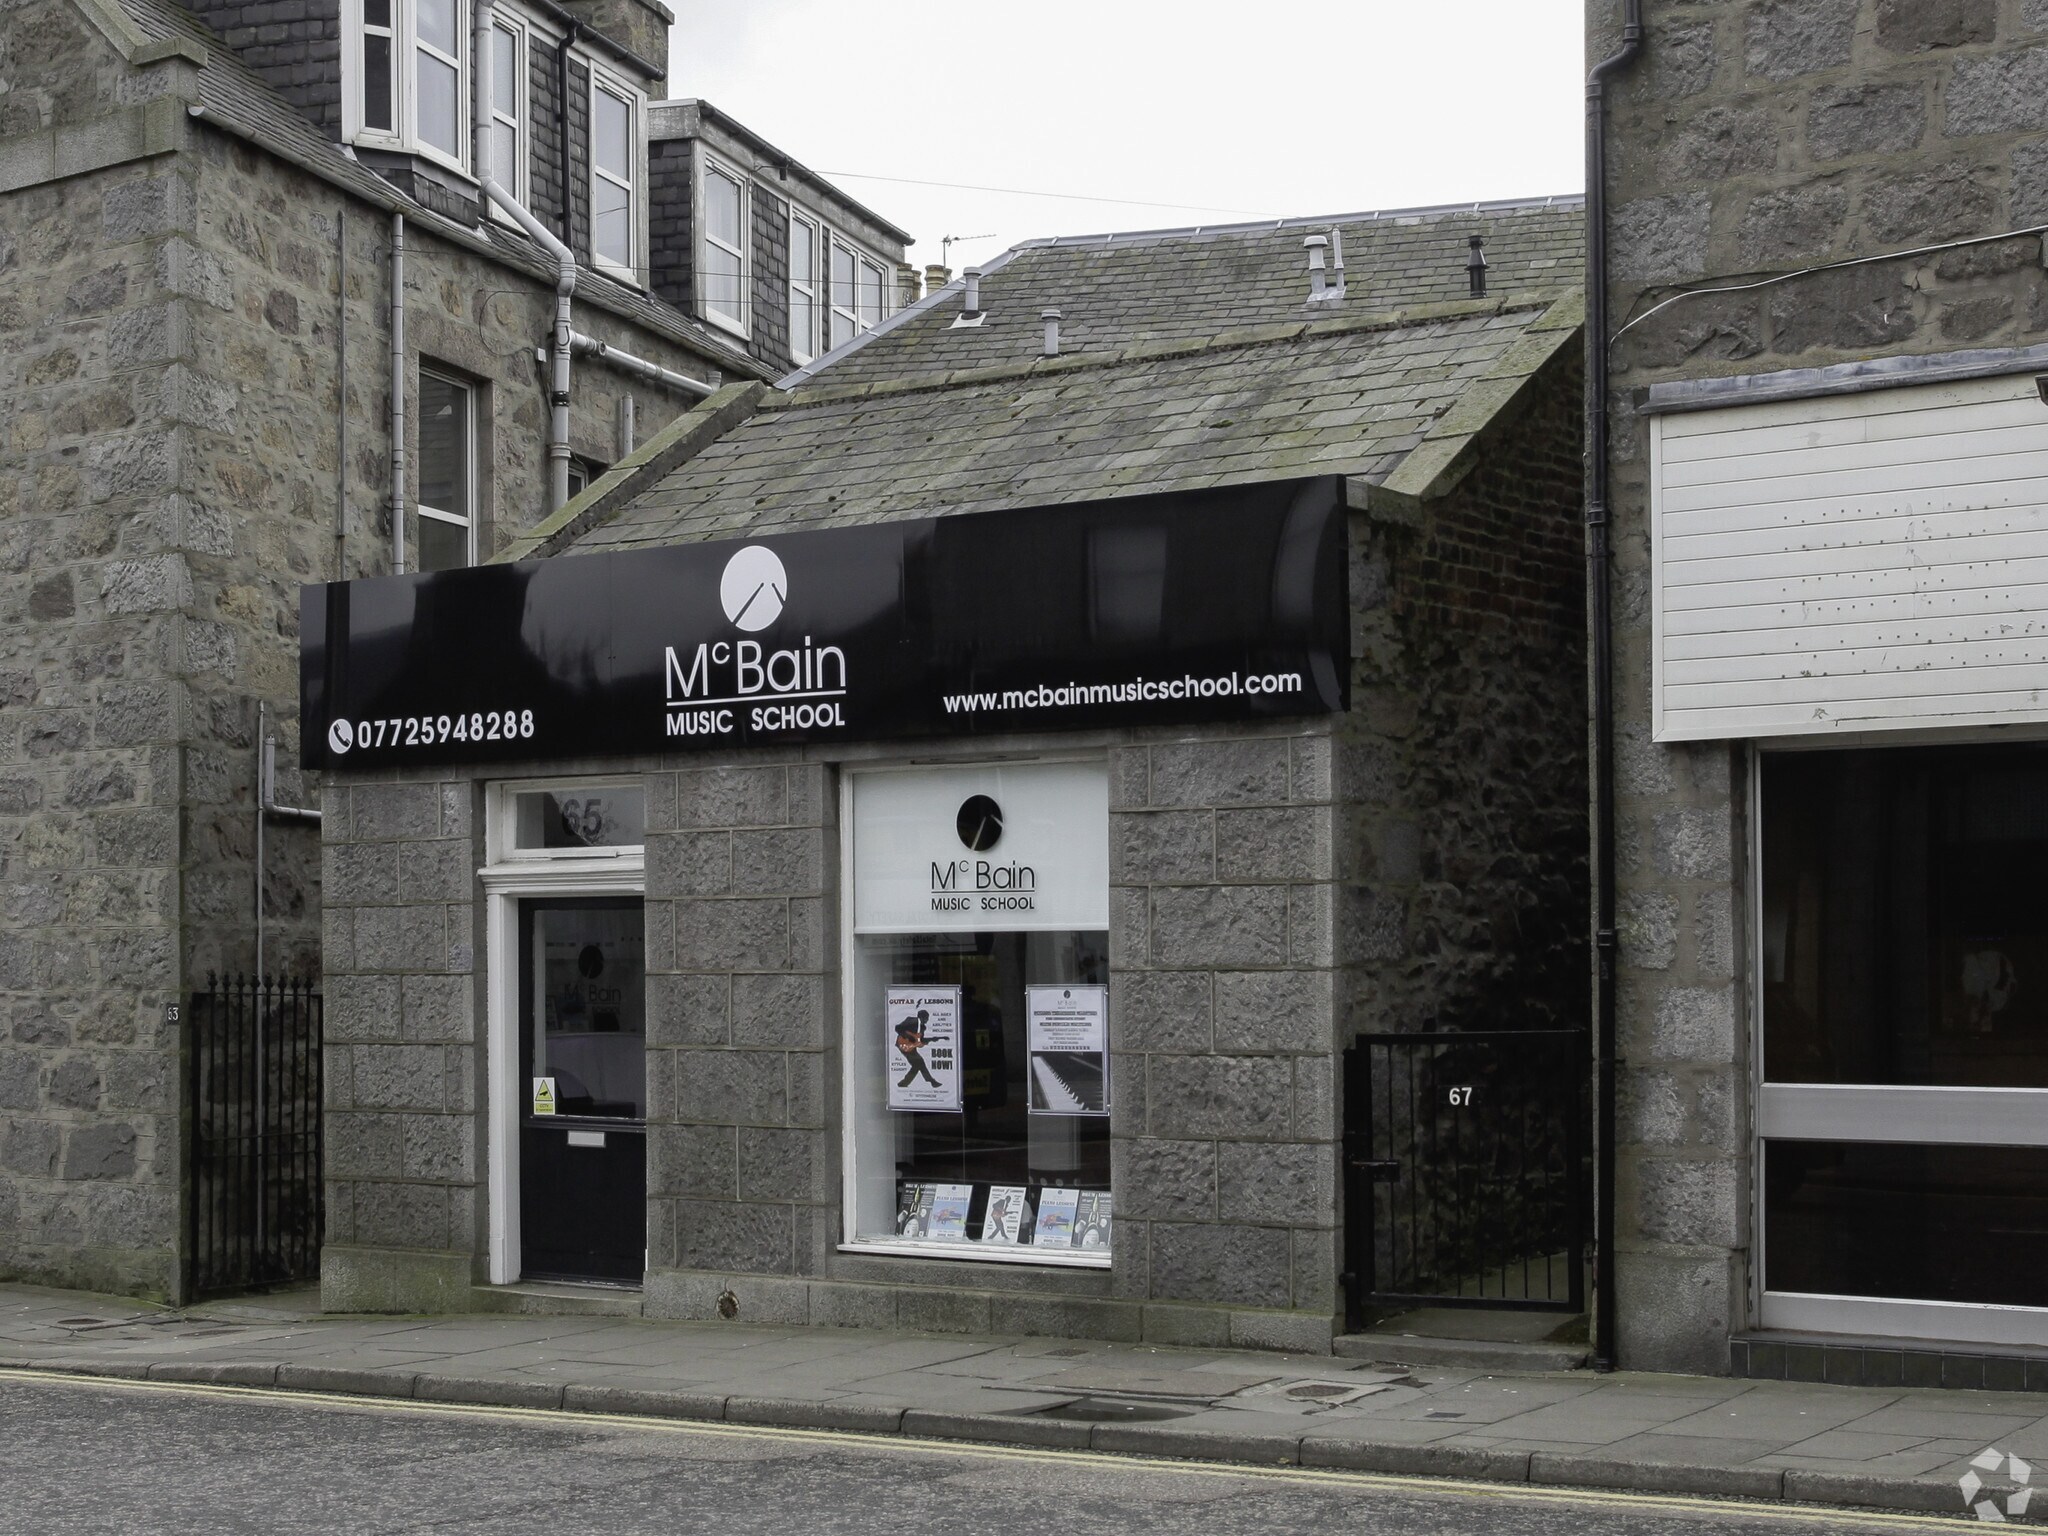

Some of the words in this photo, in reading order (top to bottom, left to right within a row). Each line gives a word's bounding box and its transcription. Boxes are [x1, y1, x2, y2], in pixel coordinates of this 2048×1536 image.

[943, 671, 1301, 713] www.mcbainmusicschool.com
[358, 709, 535, 749] 07725948288
[666, 708, 734, 736] MUSIC
[751, 702, 845, 731] SCHOOL
[562, 798, 602, 838] 65
[931, 897, 970, 911] MUSIC
[981, 896, 1035, 910] SCHOOL
[931, 1048, 953, 1058] BOOK
[1449, 1087, 1472, 1105] 67
